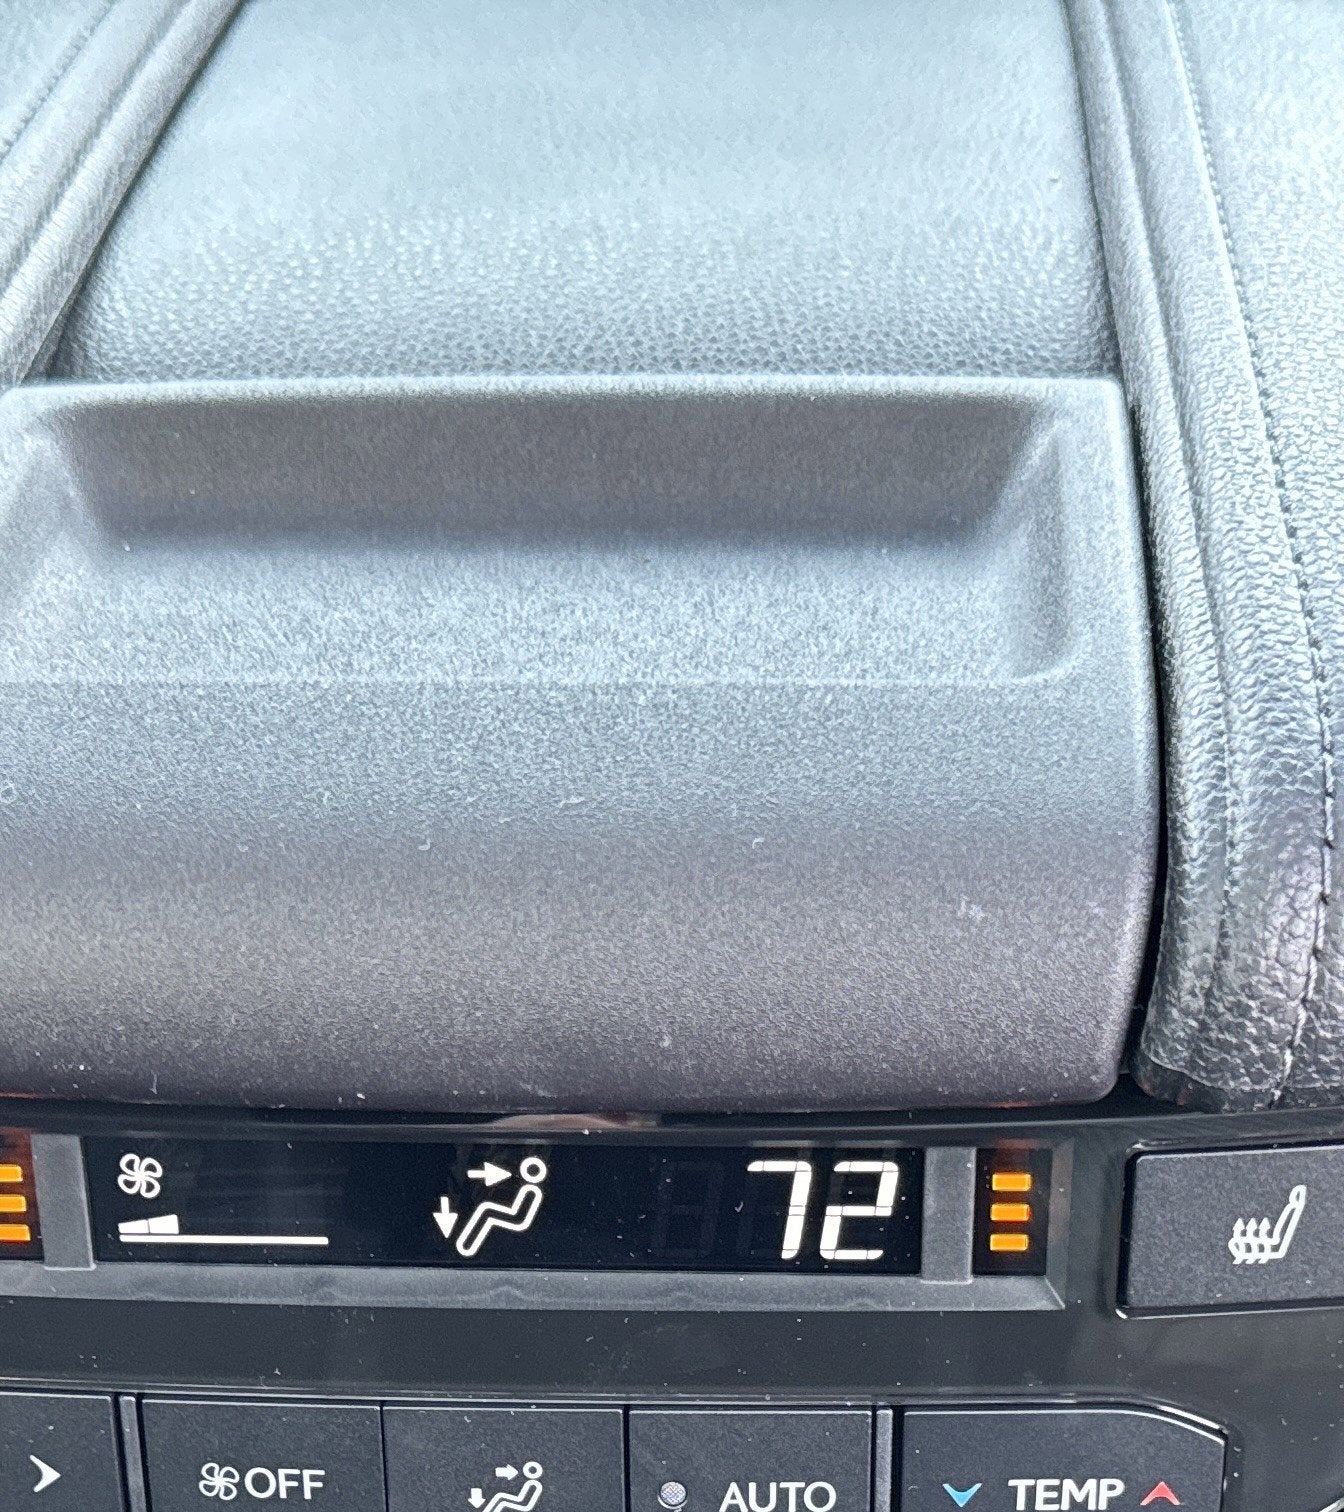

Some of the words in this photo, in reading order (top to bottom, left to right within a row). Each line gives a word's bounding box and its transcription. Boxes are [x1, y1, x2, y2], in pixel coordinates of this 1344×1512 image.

[747, 1160, 902, 1260] 72
[244, 1466, 325, 1500] OFF
[1007, 1477, 1125, 1511] TEMP
